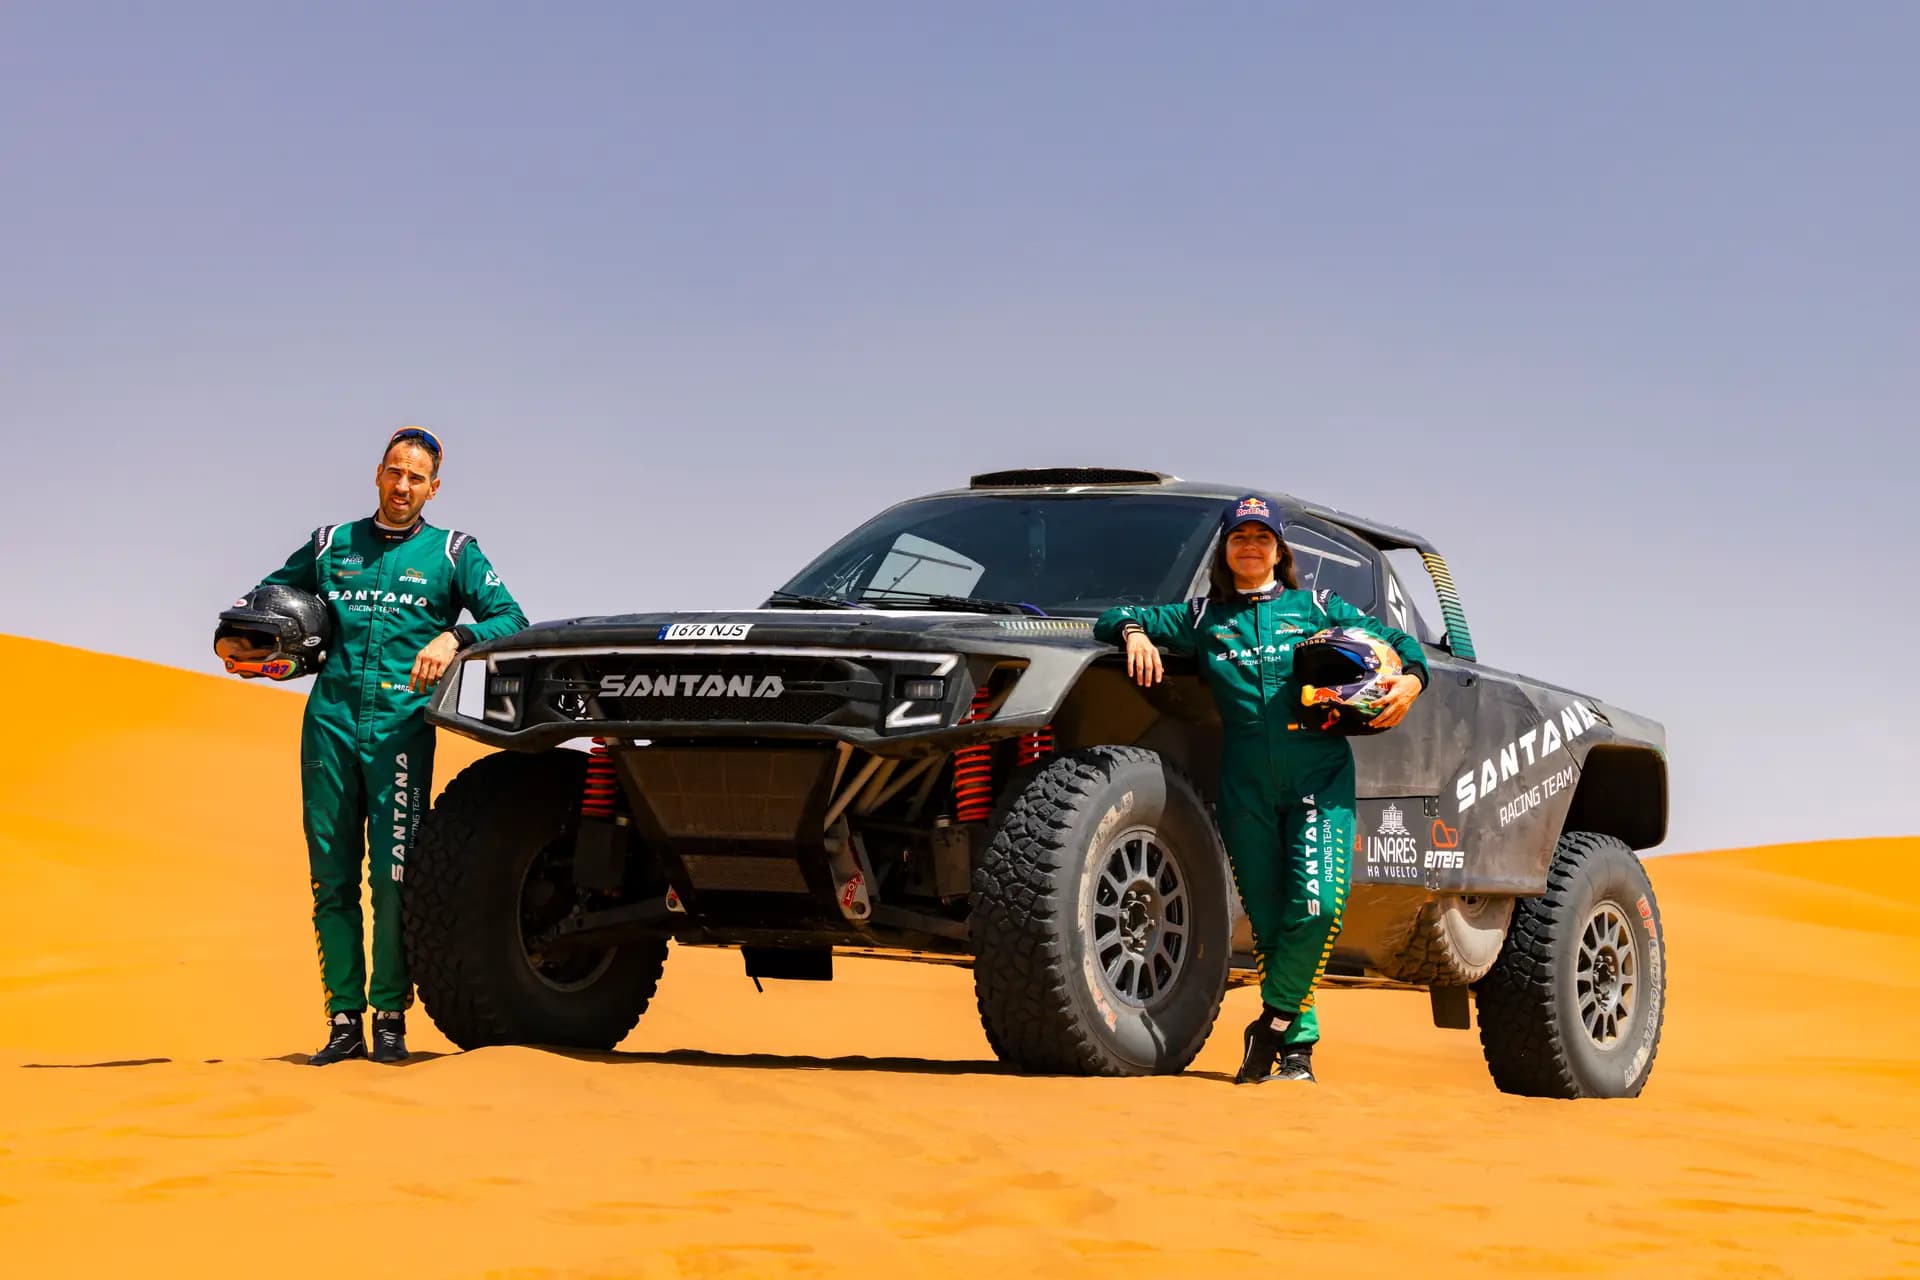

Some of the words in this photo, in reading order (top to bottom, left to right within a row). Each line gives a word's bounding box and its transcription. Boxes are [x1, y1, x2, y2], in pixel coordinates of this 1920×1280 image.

[328, 590, 428, 607] SANTANA
[379, 606, 400, 615] TEAM
[672, 624, 707, 637] 1676
[709, 624, 747, 637] NJS
[1215, 643, 1291, 661] SANTAN
[1264, 655, 1282, 663] TEAM
[598, 674, 785, 698] SANTANA
[1456, 700, 1600, 813] SANTANA
[413, 787, 421, 811] TEAM
[1499, 788, 1541, 828] RACING
[1541, 765, 1574, 799] TEAM
[391, 752, 409, 883] SANTANA
[1322, 819, 1333, 845] TEAM
[1302, 794, 1320, 917] SANTANA
[1367, 836, 1417, 864] LINARES
[1324, 846, 1334, 883] RACING
[1367, 865, 1380, 877] HA
[1383, 865, 1418, 878] VUELTO
